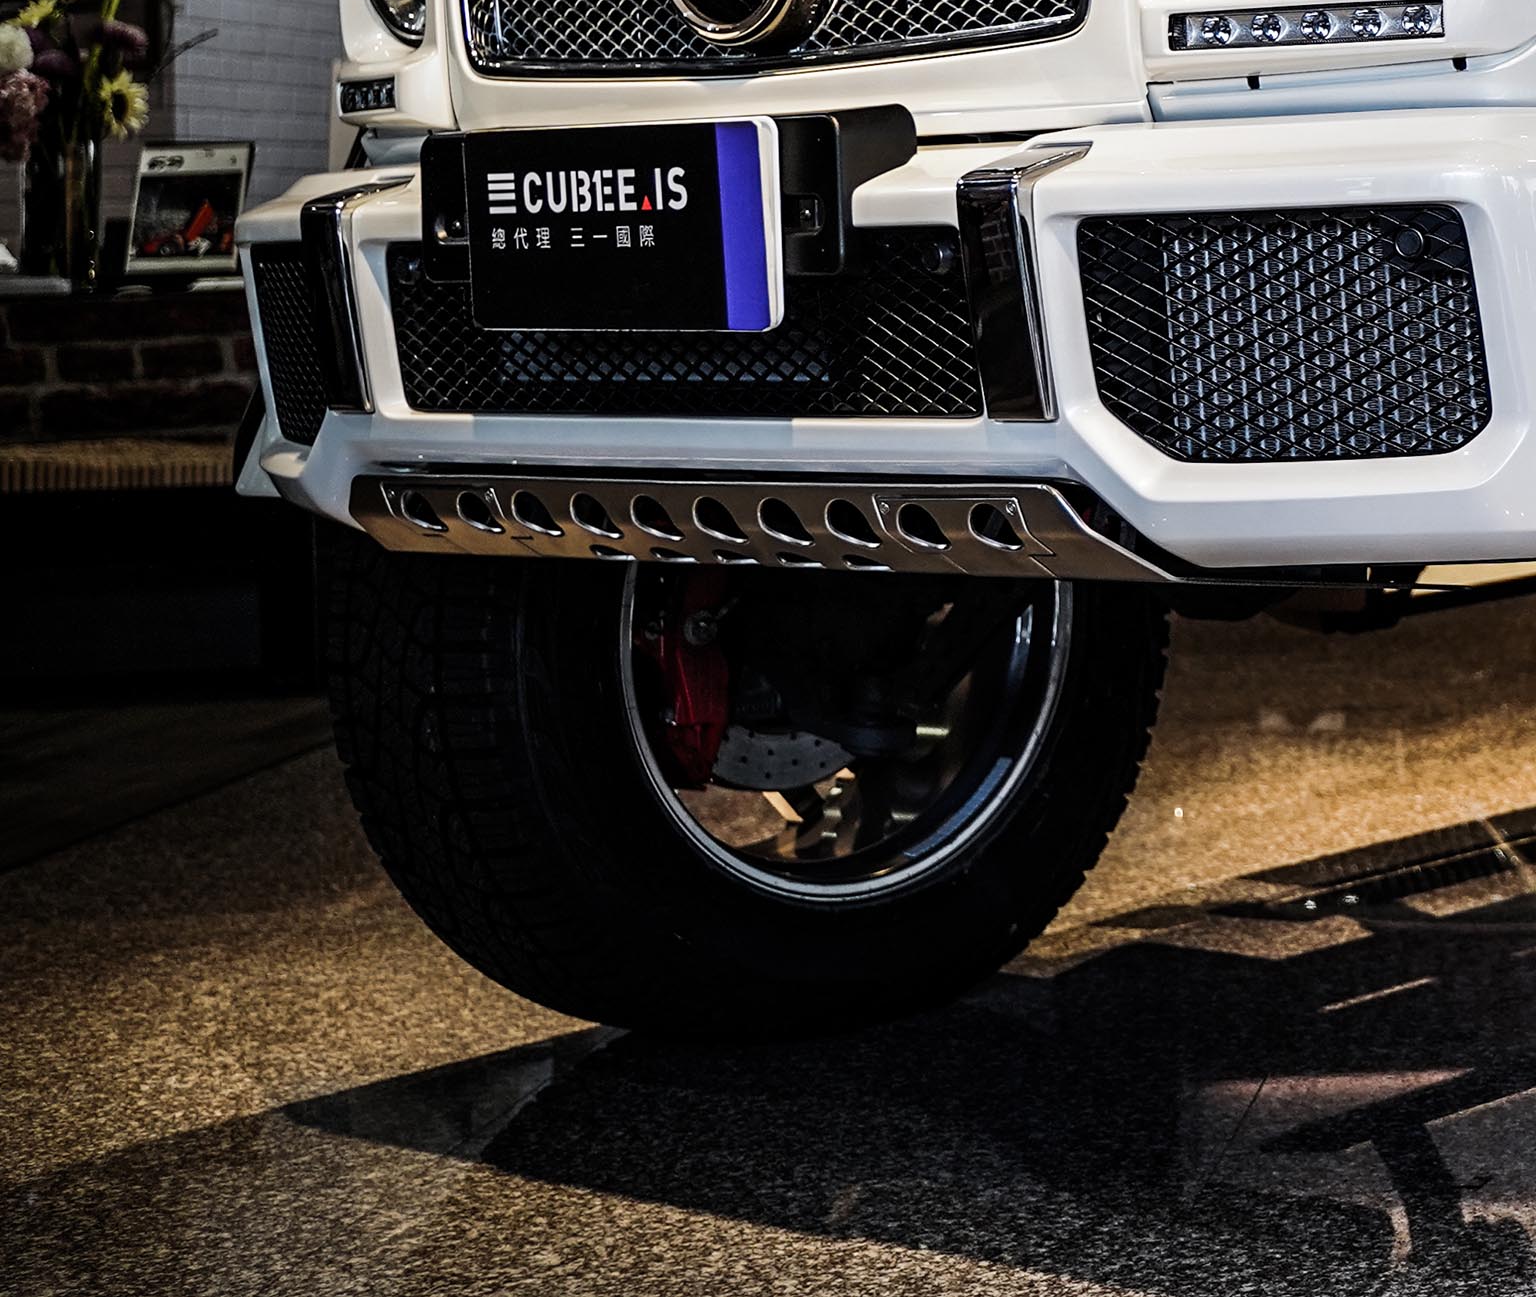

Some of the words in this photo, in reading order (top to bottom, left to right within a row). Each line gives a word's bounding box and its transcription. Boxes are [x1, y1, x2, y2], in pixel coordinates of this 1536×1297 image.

[491, 226, 552, 250] 總代理
[569, 224, 656, 249] 三一國際
